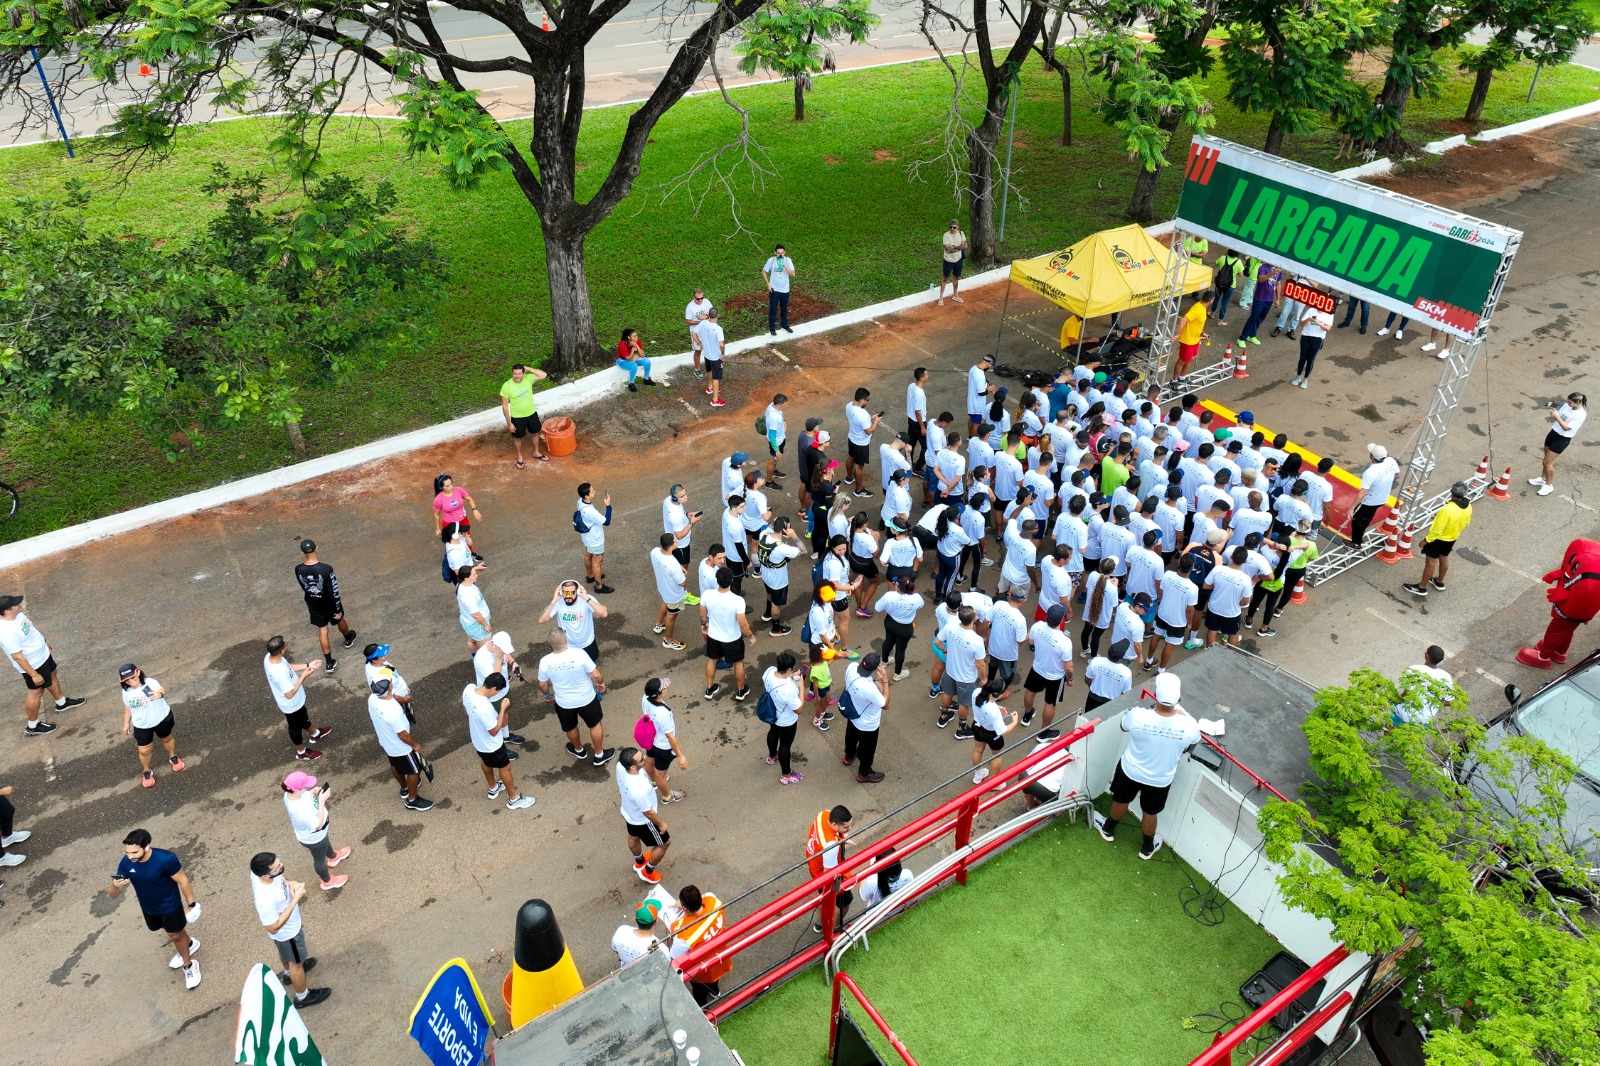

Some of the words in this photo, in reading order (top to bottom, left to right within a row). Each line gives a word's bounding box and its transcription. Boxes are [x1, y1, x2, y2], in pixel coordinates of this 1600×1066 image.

[1218, 179, 1432, 297] LARGADA
[1478, 236, 1495, 246] 2024
[1123, 258, 1141, 271] Chip
[1285, 282, 1334, 312] 00:00:00
[1417, 299, 1448, 317] 5KM
[454, 986, 473, 1034] VIDA
[427, 1002, 474, 1066] ESPORTE
